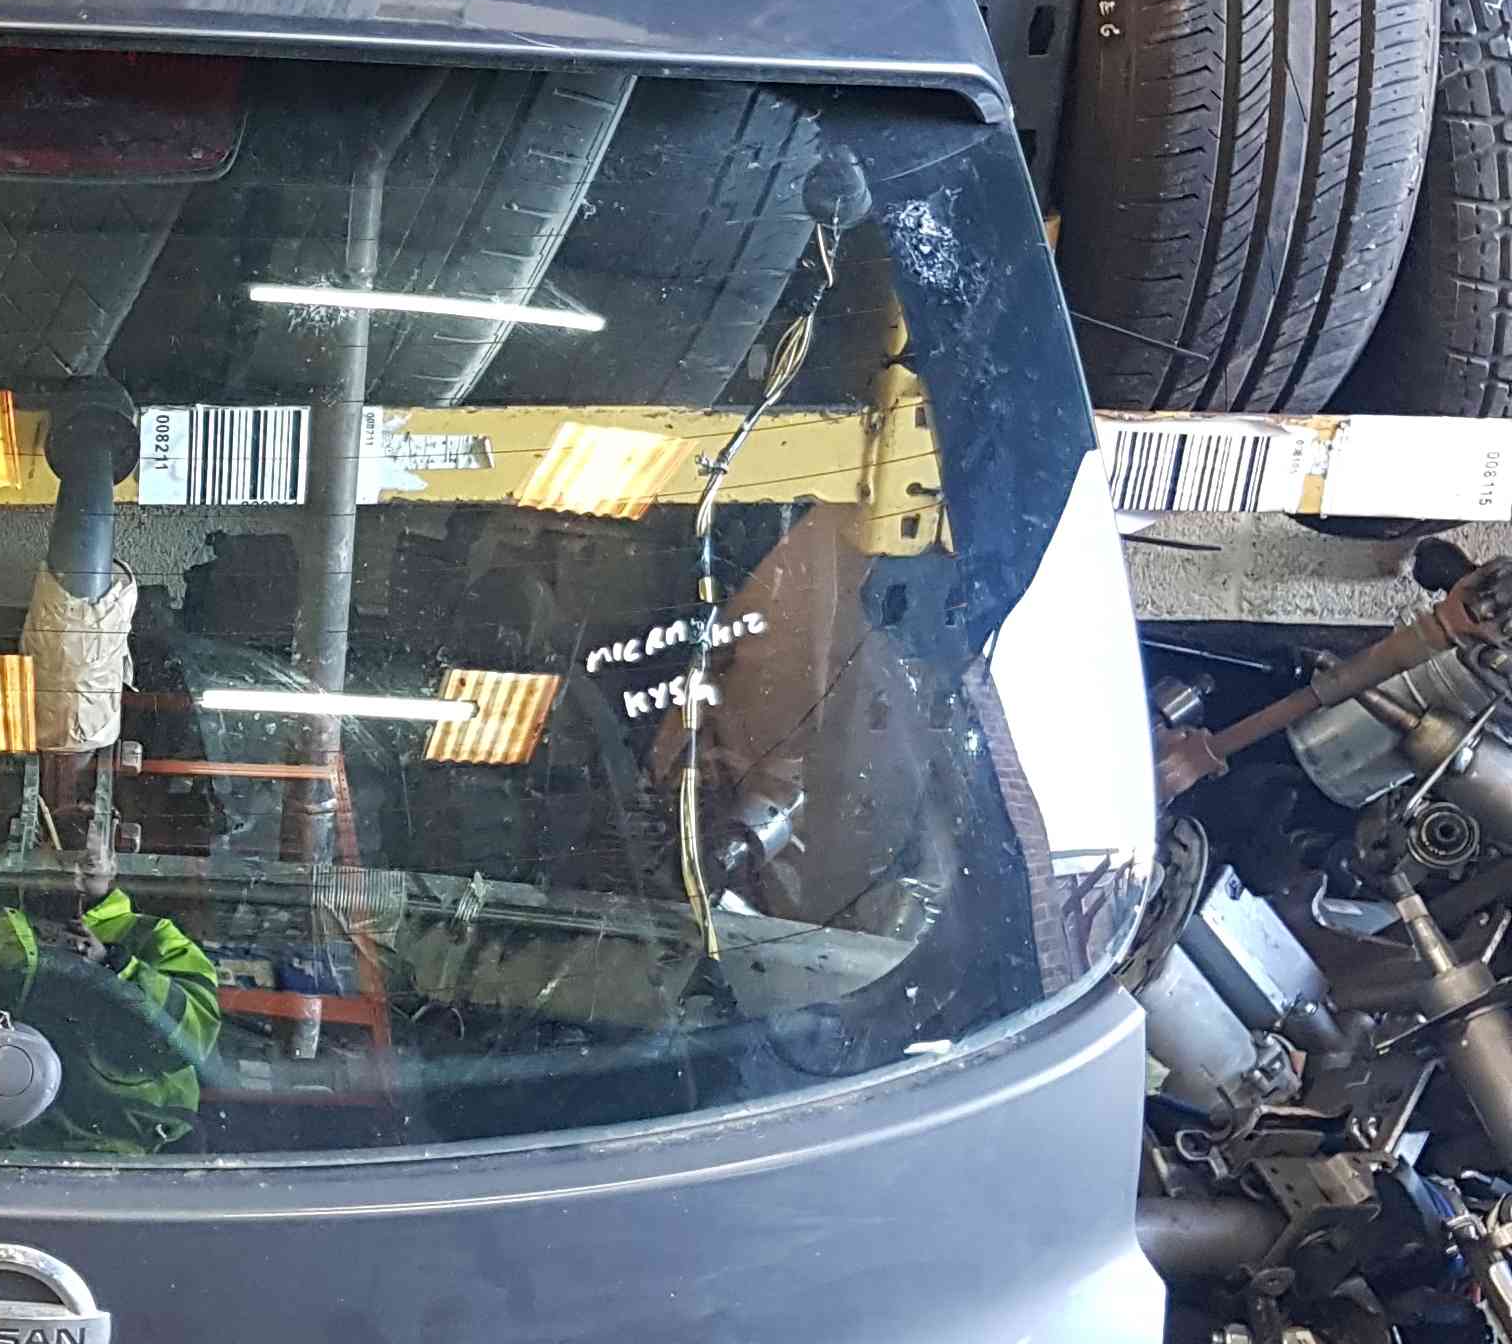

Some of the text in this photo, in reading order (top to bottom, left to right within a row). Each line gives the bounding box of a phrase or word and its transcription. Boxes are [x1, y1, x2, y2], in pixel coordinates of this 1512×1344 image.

[154, 414, 171, 471] 008211
[1478, 451, 1501, 506] 008115
[586, 619, 688, 673] MICRA
